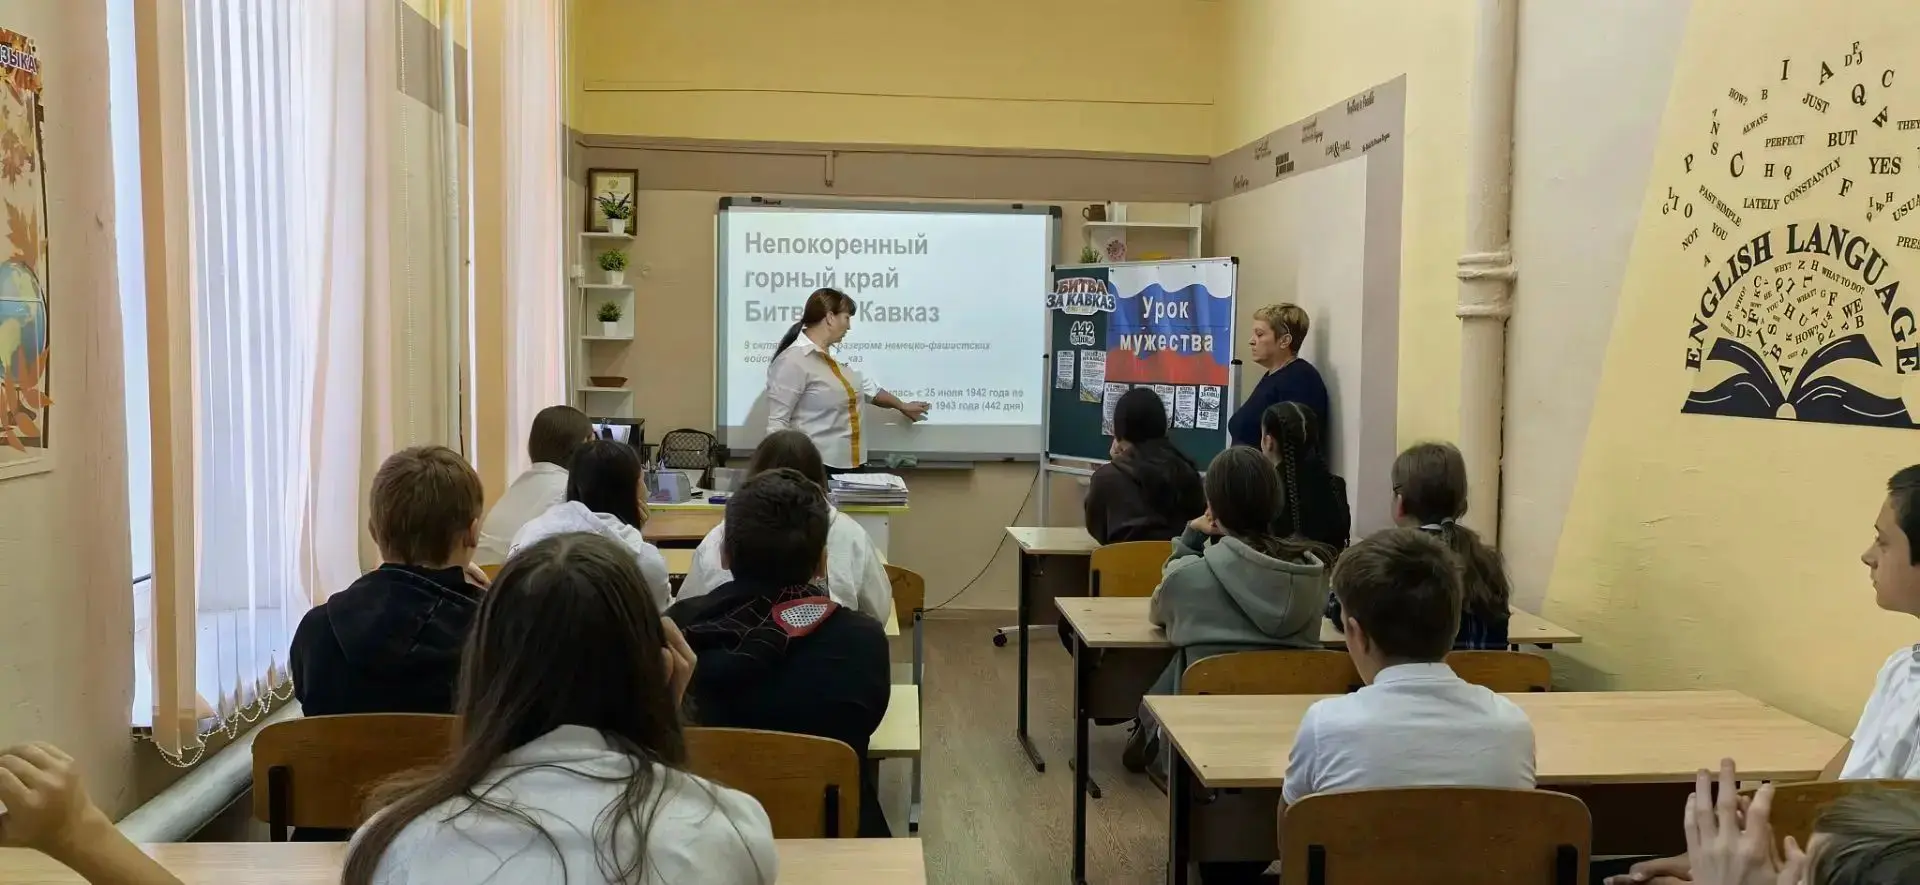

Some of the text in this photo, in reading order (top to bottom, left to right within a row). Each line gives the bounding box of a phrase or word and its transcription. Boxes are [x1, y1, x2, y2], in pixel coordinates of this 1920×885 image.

[1853, 41, 1859, 55] F
[0, 46, 36, 72] ЗЫКА
[1845, 55, 1852, 66] D
[1857, 51, 1862, 64] J
[1781, 59, 1790, 80] I
[1819, 61, 1834, 85] A
[1882, 70, 1894, 87] C
[1729, 88, 1748, 105] HOW?
[1762, 89, 1768, 100] B
[1803, 93, 1829, 113] JUST
[1852, 84, 1866, 106] Q
[1743, 113, 1767, 134] ALWAYS
[1872, 106, 1887, 127] W
[1710, 122, 1720, 135] N
[1765, 135, 1804, 147] PERFECT
[1828, 130, 1857, 147] BUT
[1711, 142, 1718, 155] S
[1684, 154, 1693, 173] P
[1730, 151, 1744, 177] C
[1764, 164, 1775, 177] H
[1869, 157, 1901, 174] YES
[1784, 166, 1791, 180] Q
[1784, 157, 1840, 204] CONSTANTLY
[1669, 187, 1674, 199] L
[1839, 178, 1853, 196] F
[1699, 185, 1741, 226] PAST SIMPLE
[1744, 198, 1780, 210] LATELY
[1886, 192, 1893, 203] H
[1663, 203, 1669, 215] G
[1876, 202, 1884, 212] W
[1682, 228, 1698, 250] NOT
[1712, 223, 1728, 240] YOU
[745, 232, 928, 259] Непокоренный
[1775, 262, 1791, 273] WHY?
[1798, 260, 1805, 269] Z
[1811, 260, 1819, 271] H
[745, 267, 900, 293] горный край
[1058, 279, 1107, 295] БИТВА
[1754, 276, 1761, 288] C
[1776, 278, 1783, 292] Q
[1822, 267, 1865, 294] WHAT TO DO?
[1047, 294, 1064, 308] ЗА
[1067, 293, 1116, 310] КАВКАЗ
[1685, 222, 1920, 375] ENGLISH LANGUAGE
[1797, 289, 1816, 303] WHAT?
[1828, 292, 1838, 306] F
[745, 301, 941, 322] Битв Кавказ
[1143, 296, 1188, 323] Урок
[1783, 303, 1795, 320] H
[1842, 298, 1863, 318] WE
[1799, 313, 1808, 326] U
[1855, 315, 1864, 329] B
[1072, 322, 1094, 336] 442
[1736, 324, 1745, 338] D
[1768, 324, 1777, 335] S
[1795, 325, 1818, 344] HOW?
[1120, 334, 1213, 355] мужества
[1756, 328, 1767, 349] I
[744, 341, 750, 350] 9
[885, 341, 990, 354] немецко-фашистских
[1770, 344, 1781, 362] B
[1779, 365, 1793, 385] A
[925, 387, 936, 398] 25
[938, 389, 963, 398] июля
[966, 387, 987, 398] 1942
[989, 390, 1011, 400] года
[1013, 390, 1024, 398] по
[936, 401, 957, 411] 1943
[959, 403, 980, 414] года
[982, 401, 1001, 413] (442
[1003, 401, 1025, 413] дня)
